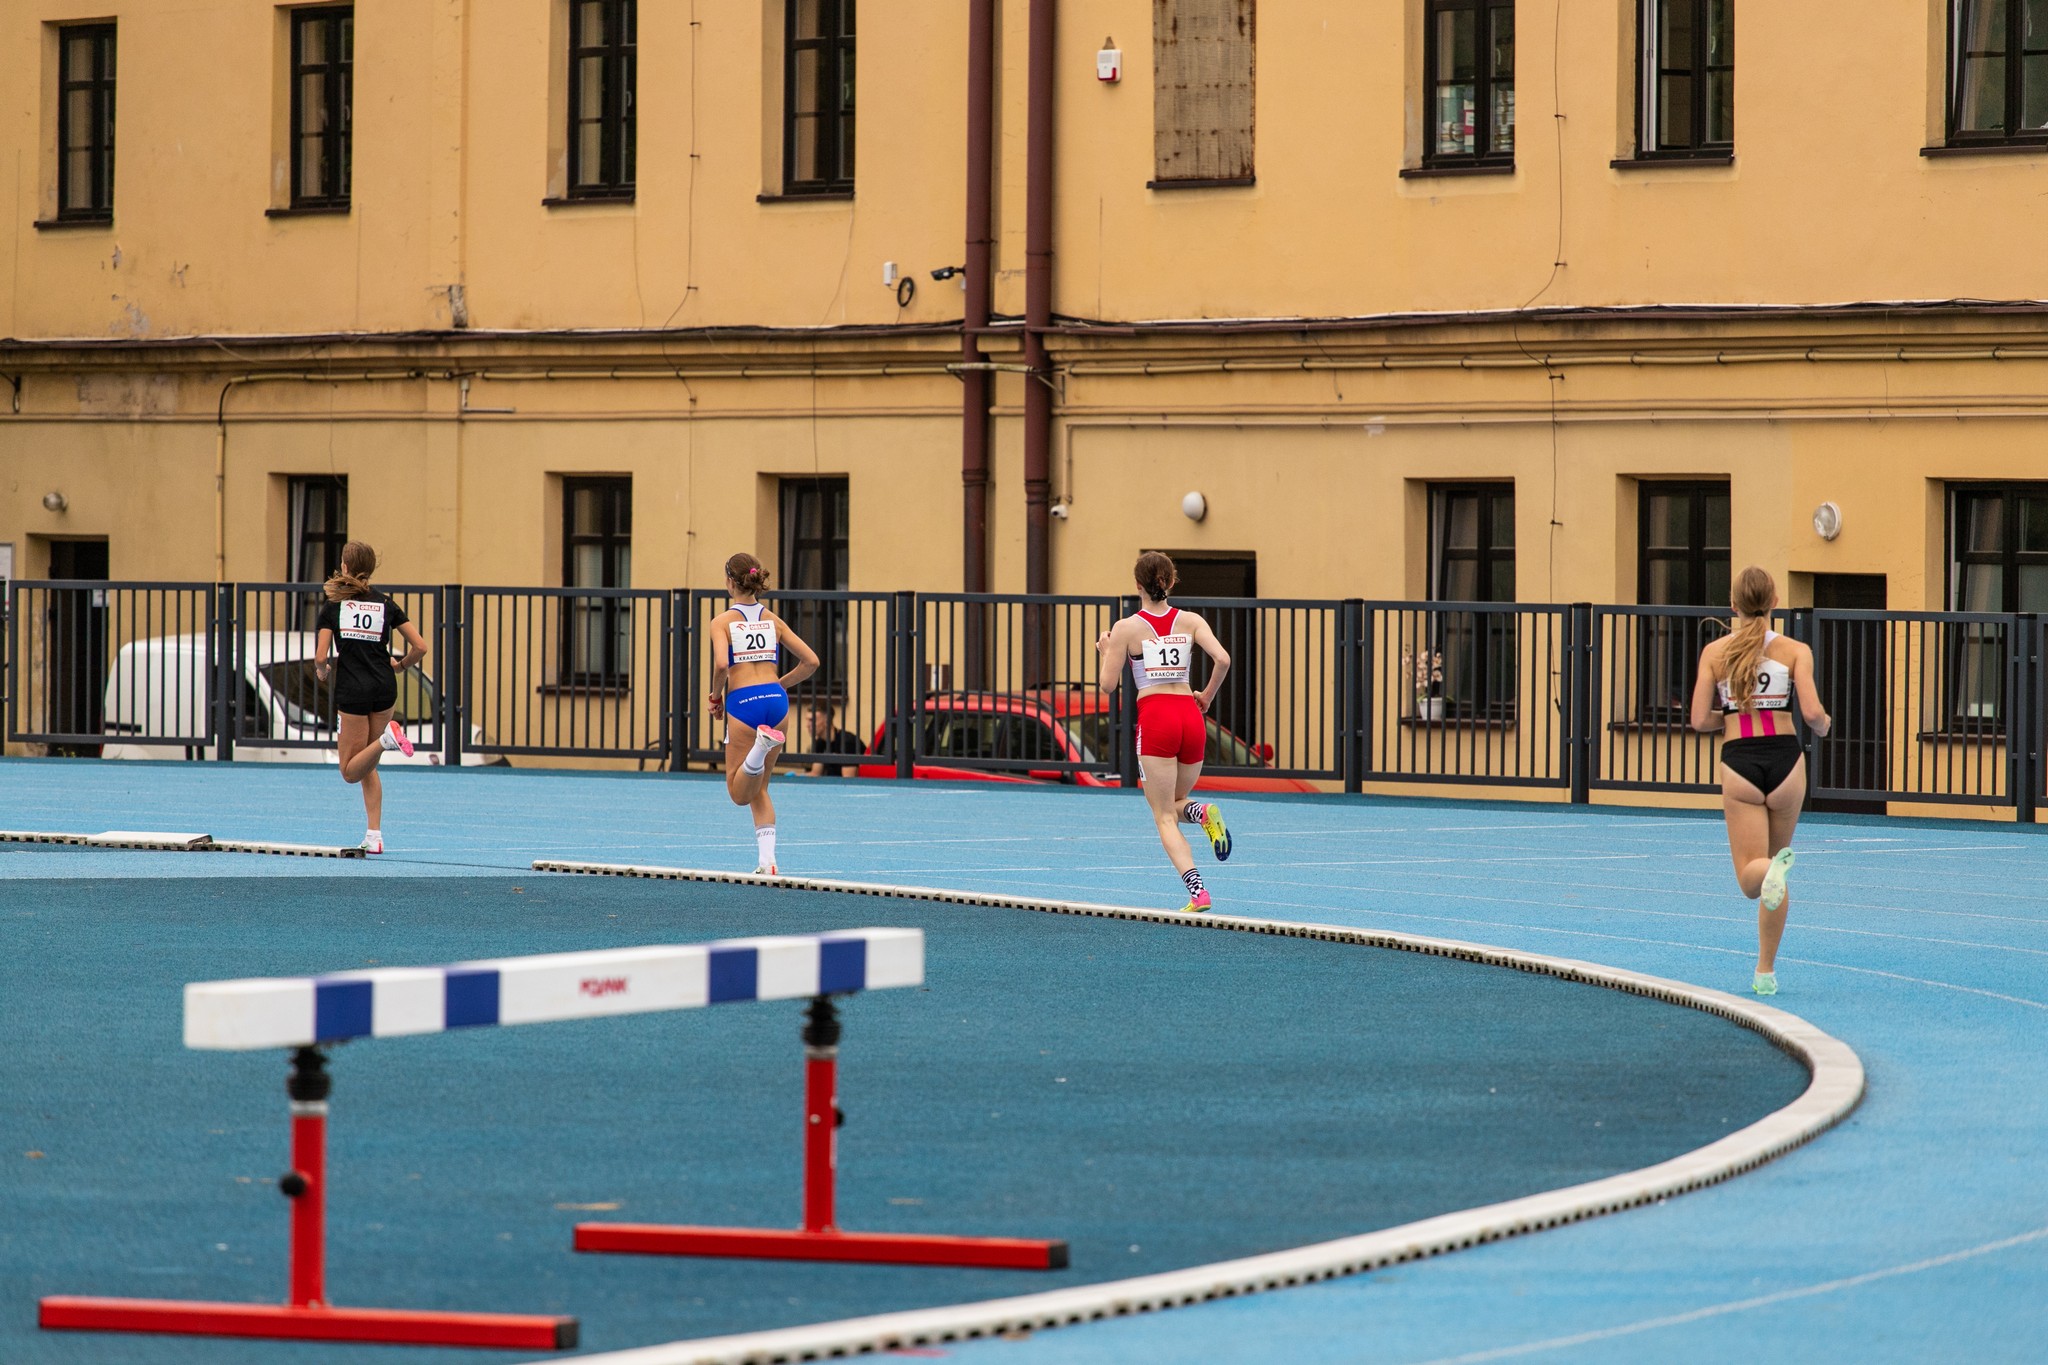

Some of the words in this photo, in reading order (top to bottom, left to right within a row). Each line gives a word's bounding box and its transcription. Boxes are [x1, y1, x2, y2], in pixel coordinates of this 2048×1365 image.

[353, 613, 372, 629] 10
[745, 633, 766, 650] 20
[1159, 648, 1180, 666] 13
[1757, 672, 1771, 693] 9
